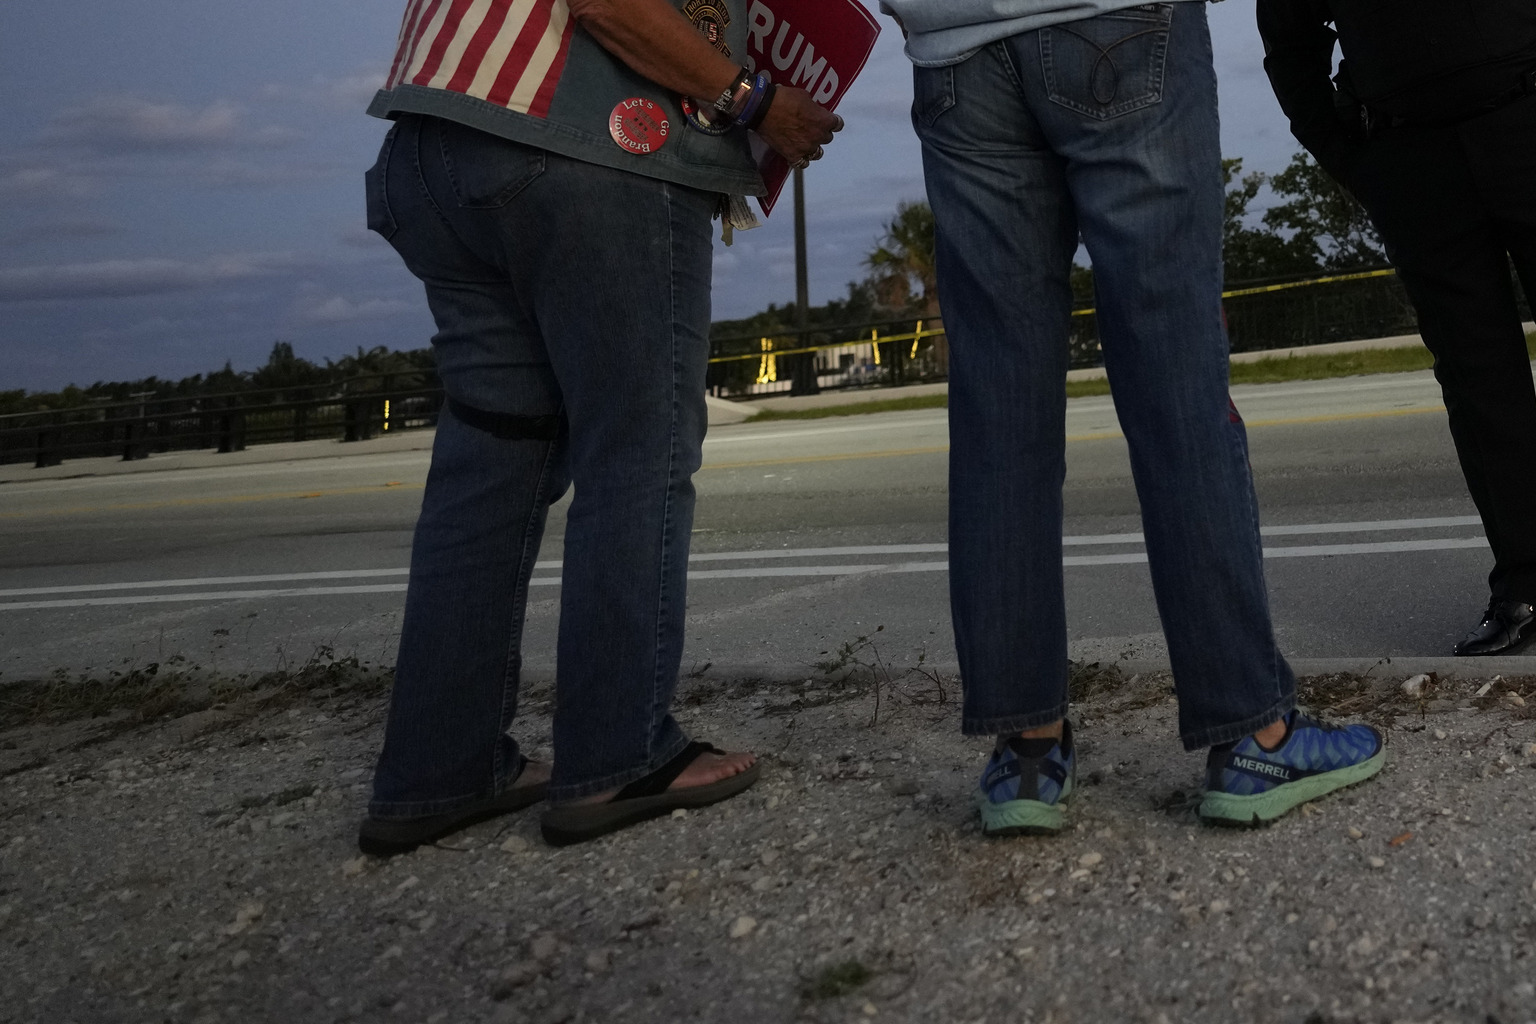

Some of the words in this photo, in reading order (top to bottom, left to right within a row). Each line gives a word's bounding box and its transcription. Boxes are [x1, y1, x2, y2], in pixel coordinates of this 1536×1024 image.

[622, 98, 654, 110] Let's
[615, 115, 651, 153] Brandon
[660, 120, 670, 136] Go
[1233, 756, 1290, 780] MERRELL
